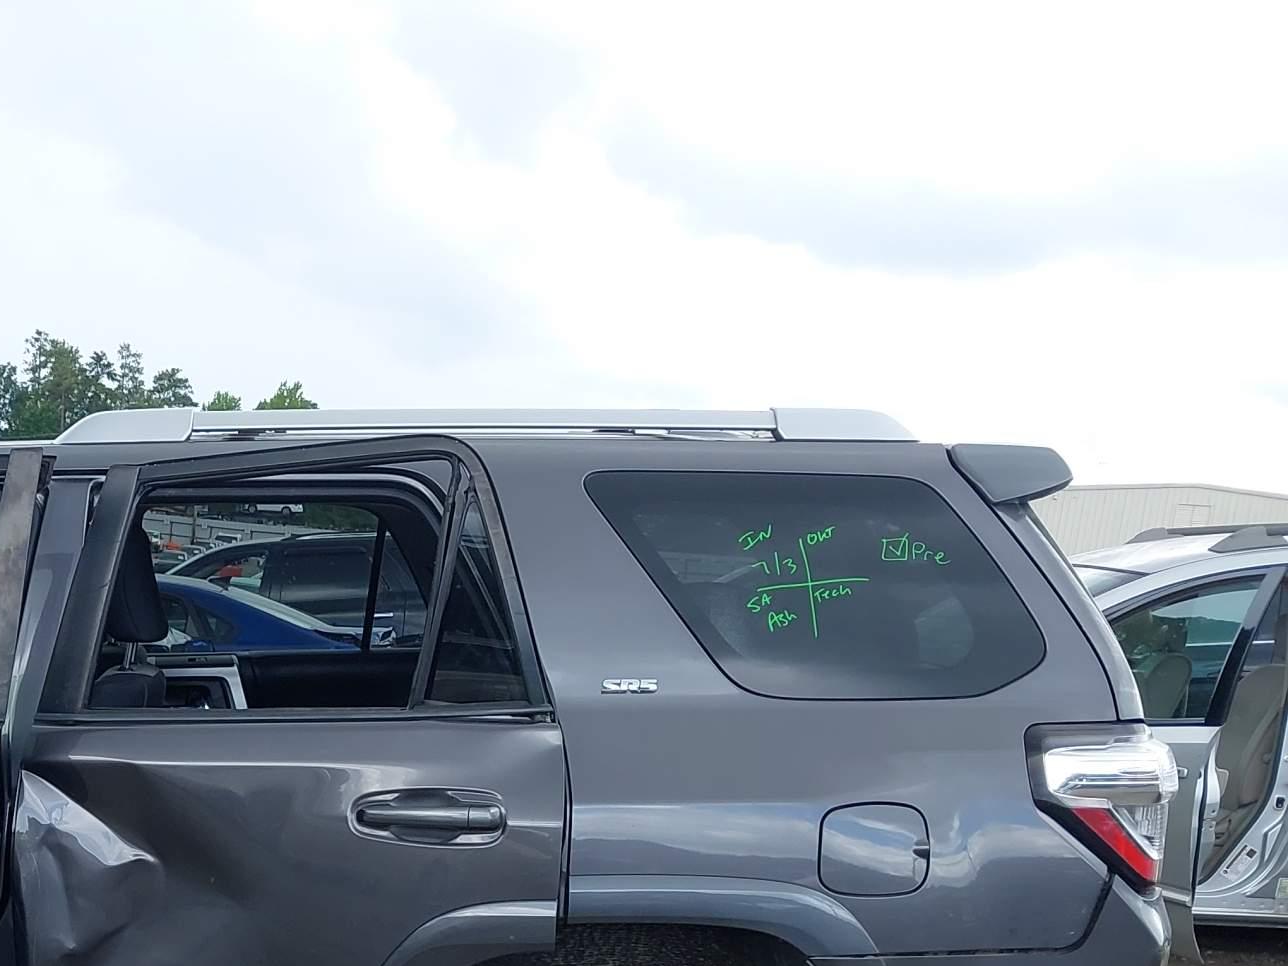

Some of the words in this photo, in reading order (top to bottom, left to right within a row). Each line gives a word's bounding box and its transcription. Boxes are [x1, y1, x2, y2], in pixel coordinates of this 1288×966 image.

[738, 524, 772, 551] IN
[751, 551, 797, 576] 7/3
[911, 542, 951, 565] Pre
[746, 593, 772, 613] SA
[814, 585, 852, 603] Tech
[601, 679, 658, 693] SR5
